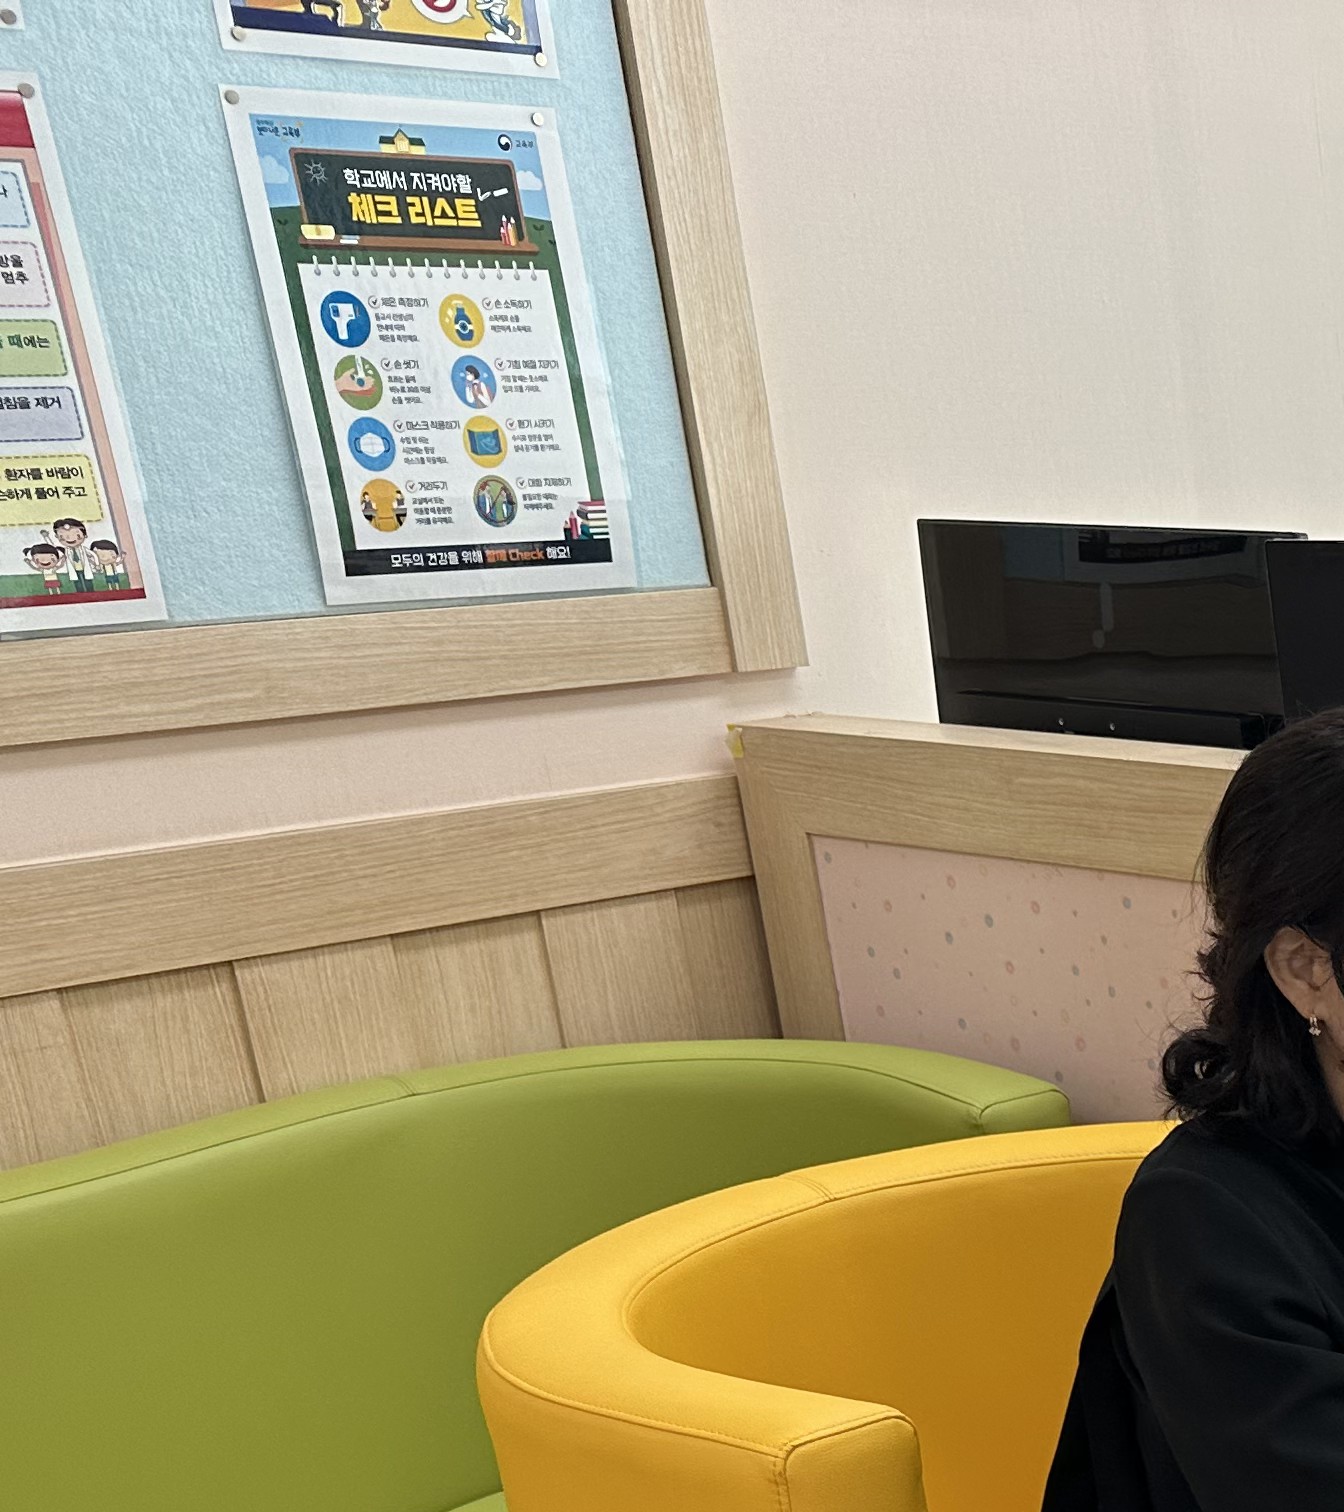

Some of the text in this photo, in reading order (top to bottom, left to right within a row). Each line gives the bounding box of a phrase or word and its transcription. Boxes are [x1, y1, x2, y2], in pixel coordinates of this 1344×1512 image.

[343, 167, 473, 194] 학교에서 지켜야할
[348, 192, 482, 228] 체크 리스트
[8, 334, 51, 349] 때에는
[34, 396, 62, 409] 제거
[4, 466, 84, 481] 환자를 바람이
[35, 486, 60, 499] 풀어
[62, 486, 88, 498] 주고
[391, 554, 424, 567] 모두의
[426, 552, 459, 566] 건강을
[461, 550, 484, 564] 위해
[508, 548, 545, 562] Check
[546, 546, 571, 559] 해요!
